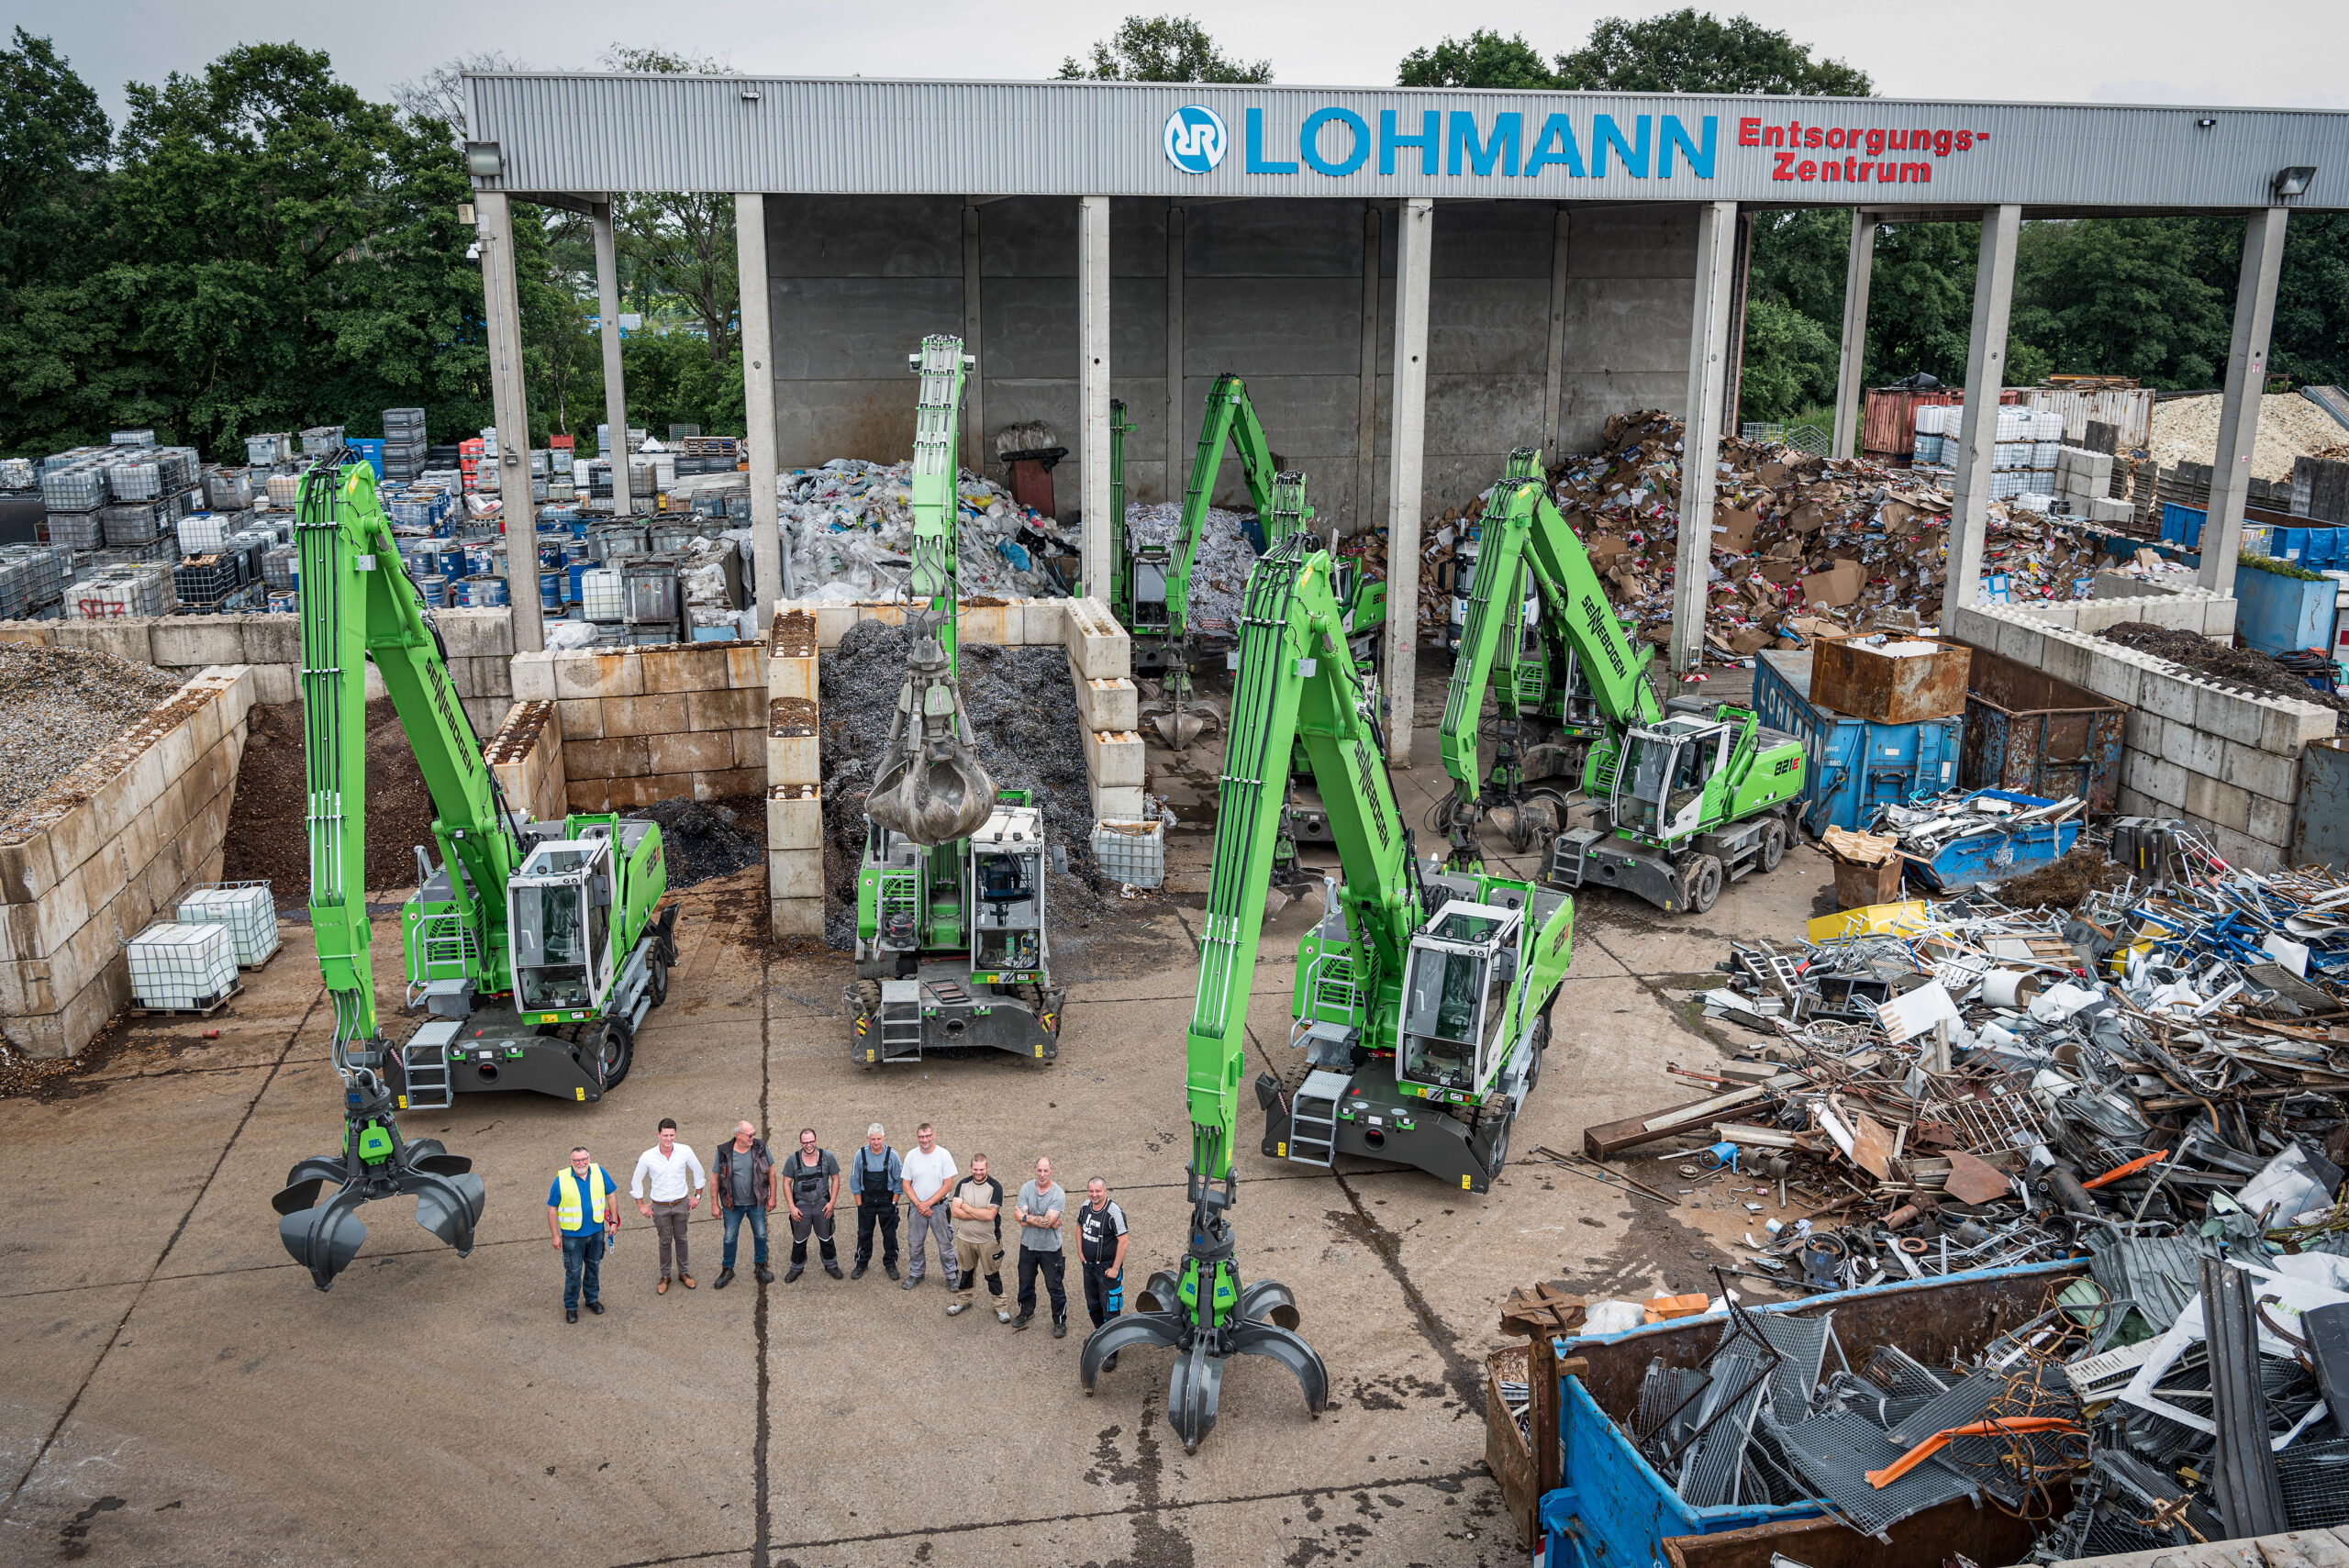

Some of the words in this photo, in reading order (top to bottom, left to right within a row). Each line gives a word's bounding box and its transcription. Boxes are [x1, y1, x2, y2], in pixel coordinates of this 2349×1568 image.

[1246, 107, 1718, 178] LOHMANN
[1739, 117, 1989, 156] Entsorgungs-
[1772, 152, 1931, 183] Zentrum
[1581, 595, 1627, 680] SENNEBOGEN
[426, 656, 473, 778] SENNEBOGEN
[1761, 677, 1822, 767] LOHMANN
[1354, 740, 1390, 852] SENNEBOGEN
[1774, 757, 1800, 776] 821E
